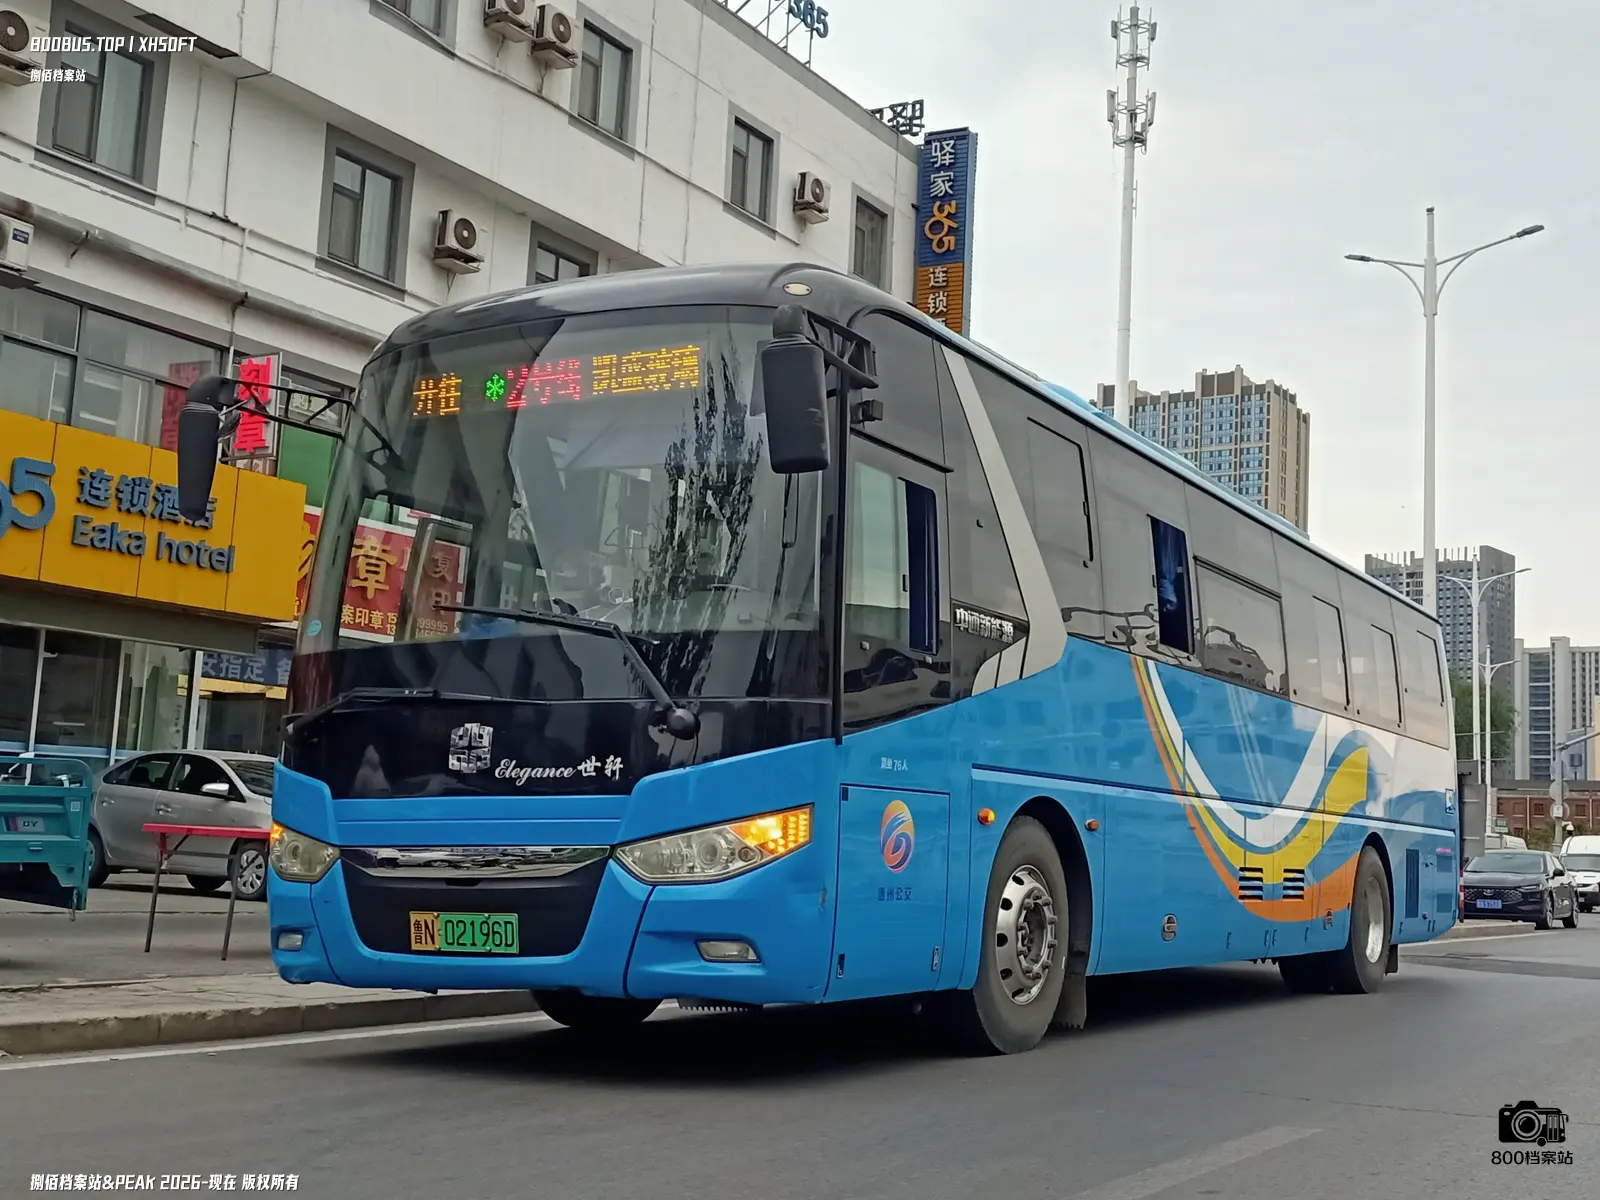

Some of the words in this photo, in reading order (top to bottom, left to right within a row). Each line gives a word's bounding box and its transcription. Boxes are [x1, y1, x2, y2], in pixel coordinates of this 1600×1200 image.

[0, 457, 56, 538] 5
[72, 514, 147, 557] Eaka
[156, 531, 236, 573] hotel
[494, 758, 578, 786] Elegance
